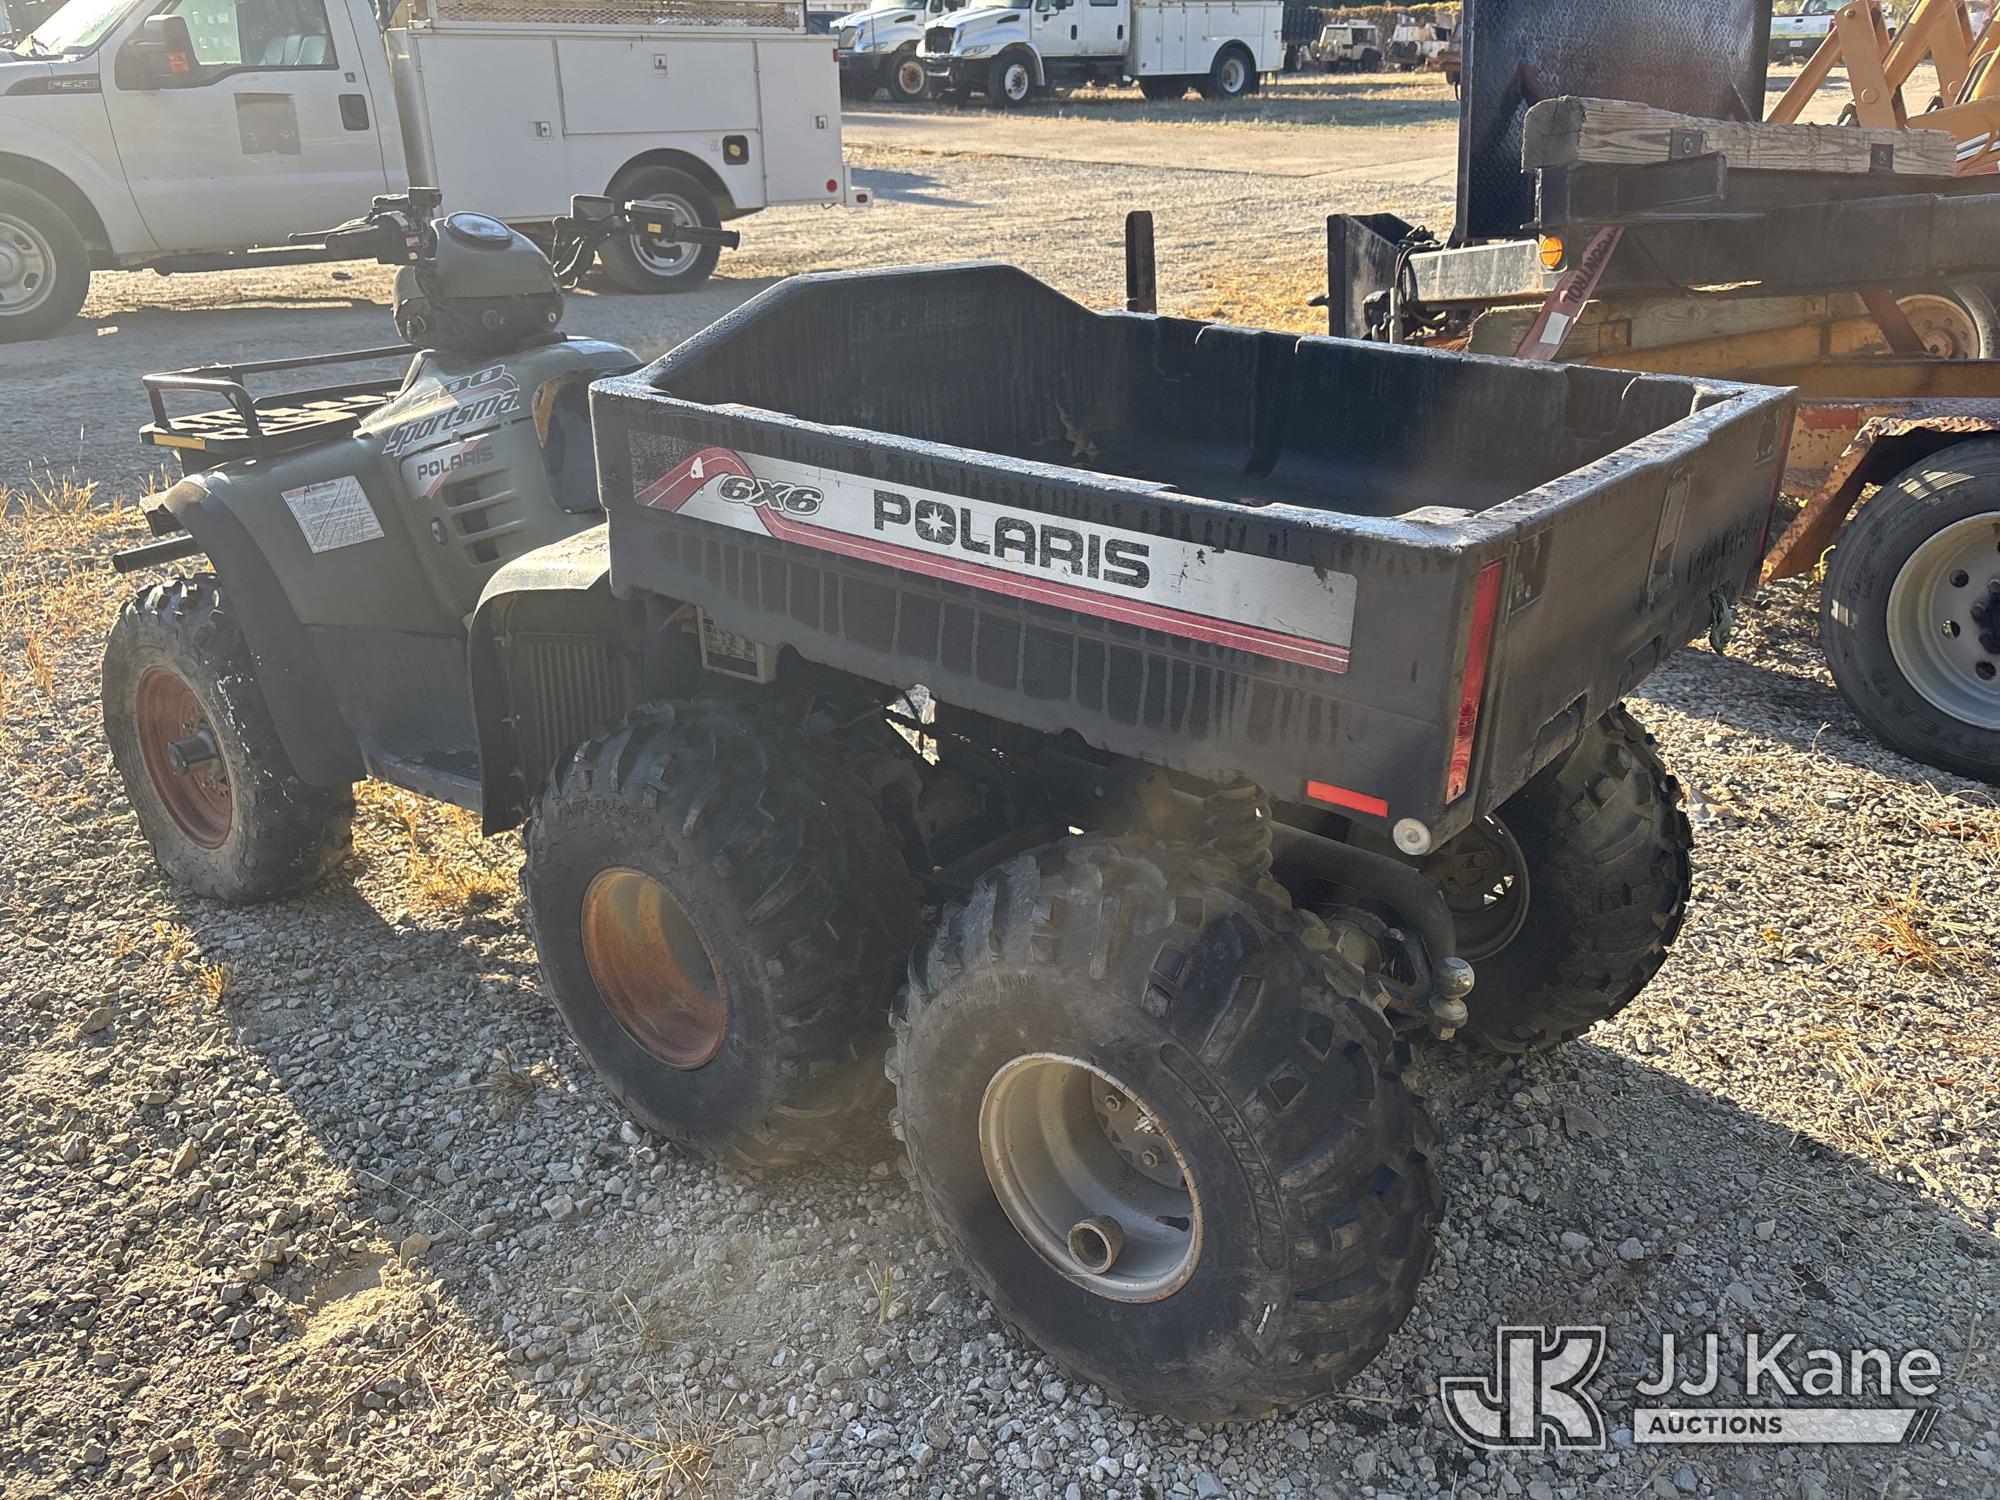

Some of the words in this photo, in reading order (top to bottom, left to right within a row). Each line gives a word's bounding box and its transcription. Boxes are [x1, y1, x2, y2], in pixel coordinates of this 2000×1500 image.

[381, 386, 521, 458] Sportsma
[417, 446, 495, 481] POLARIS
[873, 488, 1150, 589] POLARIS
